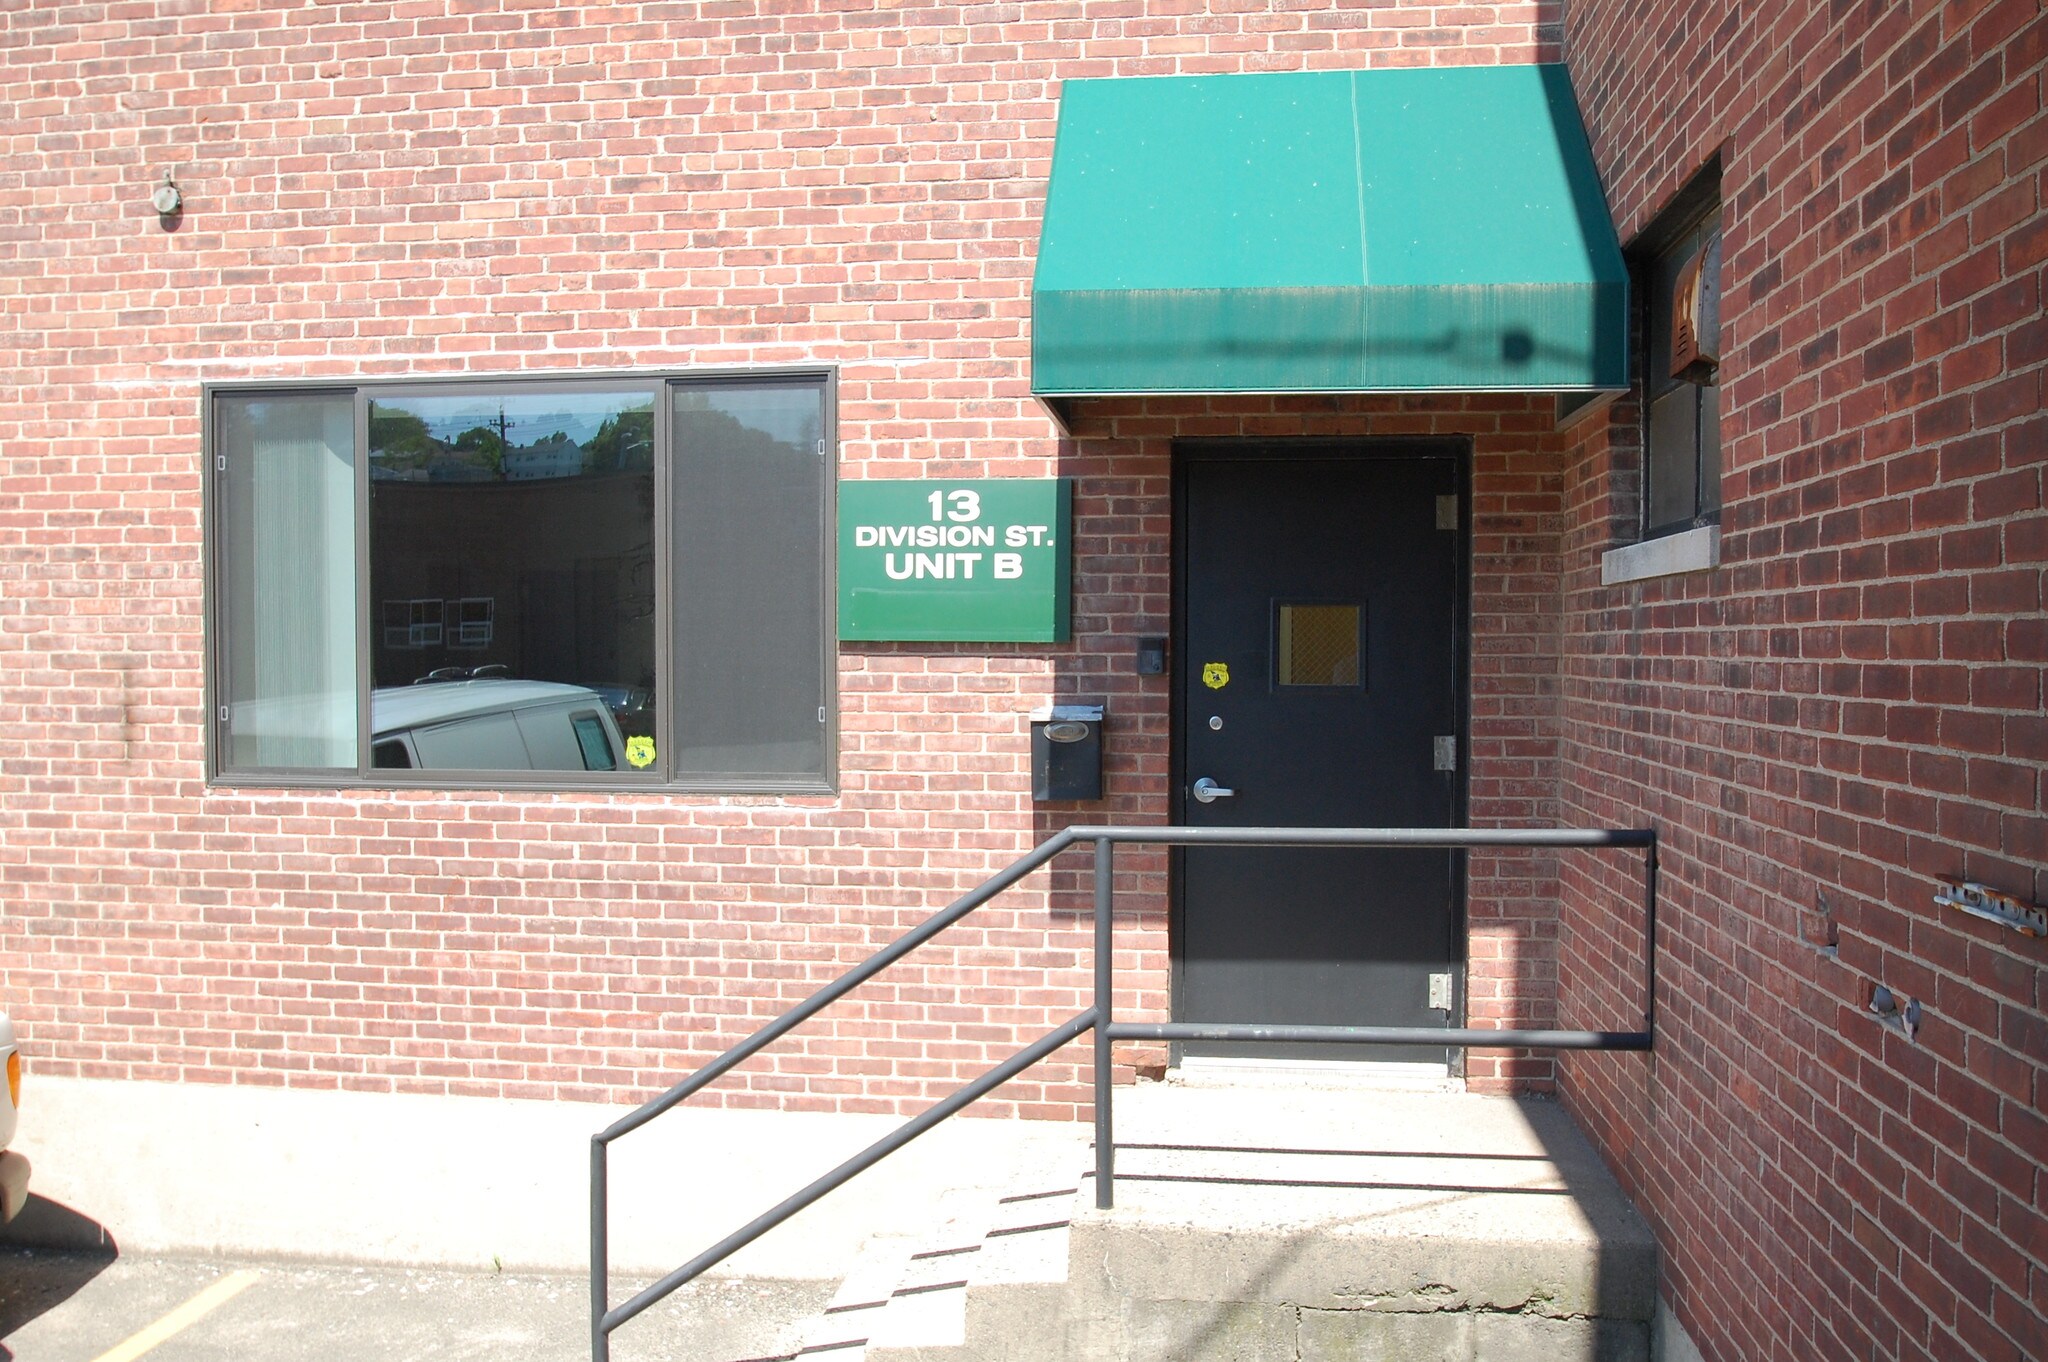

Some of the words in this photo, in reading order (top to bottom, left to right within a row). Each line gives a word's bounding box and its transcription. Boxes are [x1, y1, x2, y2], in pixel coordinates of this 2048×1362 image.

[927, 489, 981, 522] 13
[855, 525, 995, 547] DIVISION
[1004, 525, 1054, 547] ST.
[885, 552, 983, 580] UNIT
[993, 552, 1023, 580] B
